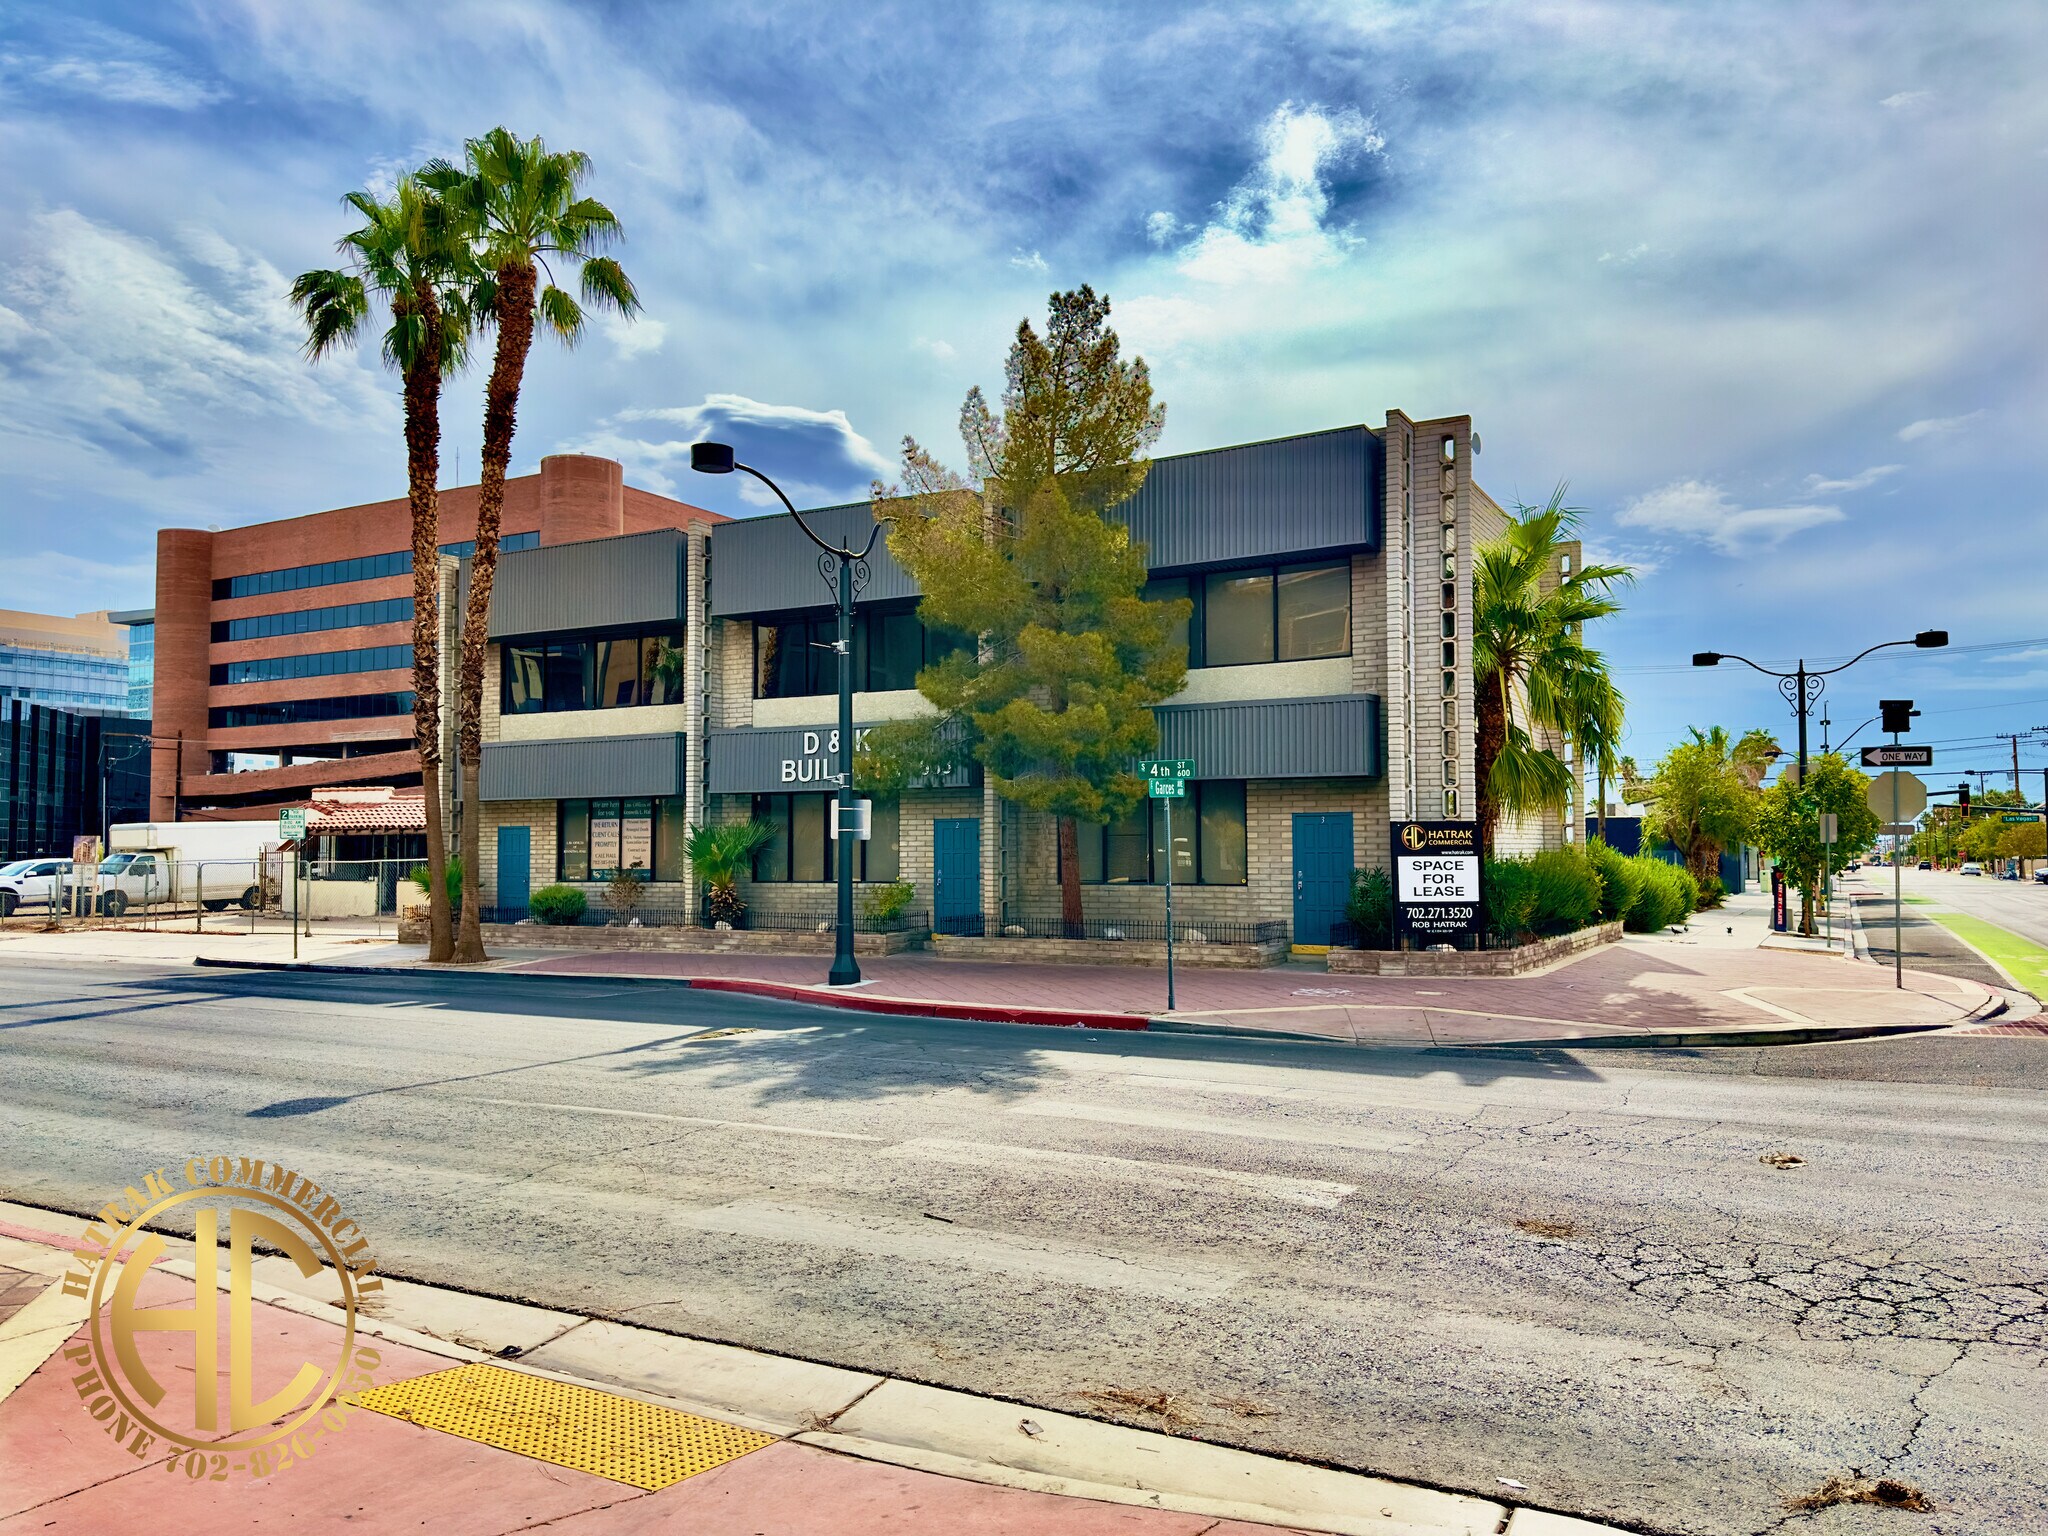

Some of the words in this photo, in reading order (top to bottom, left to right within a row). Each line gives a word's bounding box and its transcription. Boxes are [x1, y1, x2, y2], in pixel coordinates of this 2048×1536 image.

[804, 732, 819, 754] D
[855, 728, 872, 752] K
[1882, 753, 1901, 761] ONE
[1904, 753, 1925, 761] WAY
[1141, 763, 1146, 772] S
[1150, 763, 1170, 777] 4th
[1177, 761, 1186, 769] ST
[1177, 769, 1191, 777] 600
[1155, 781, 1175, 795] Garces
[281, 810, 288, 819] 2
[1321, 816, 1326, 824] 3
[1428, 830, 1473, 839] HATRAK
[1412, 860, 1464, 871] SPACE
[1423, 873, 1455, 884] FOR
[1413, 886, 1465, 897] LEASE
[1406, 906, 1473, 919] 702.271.3520
